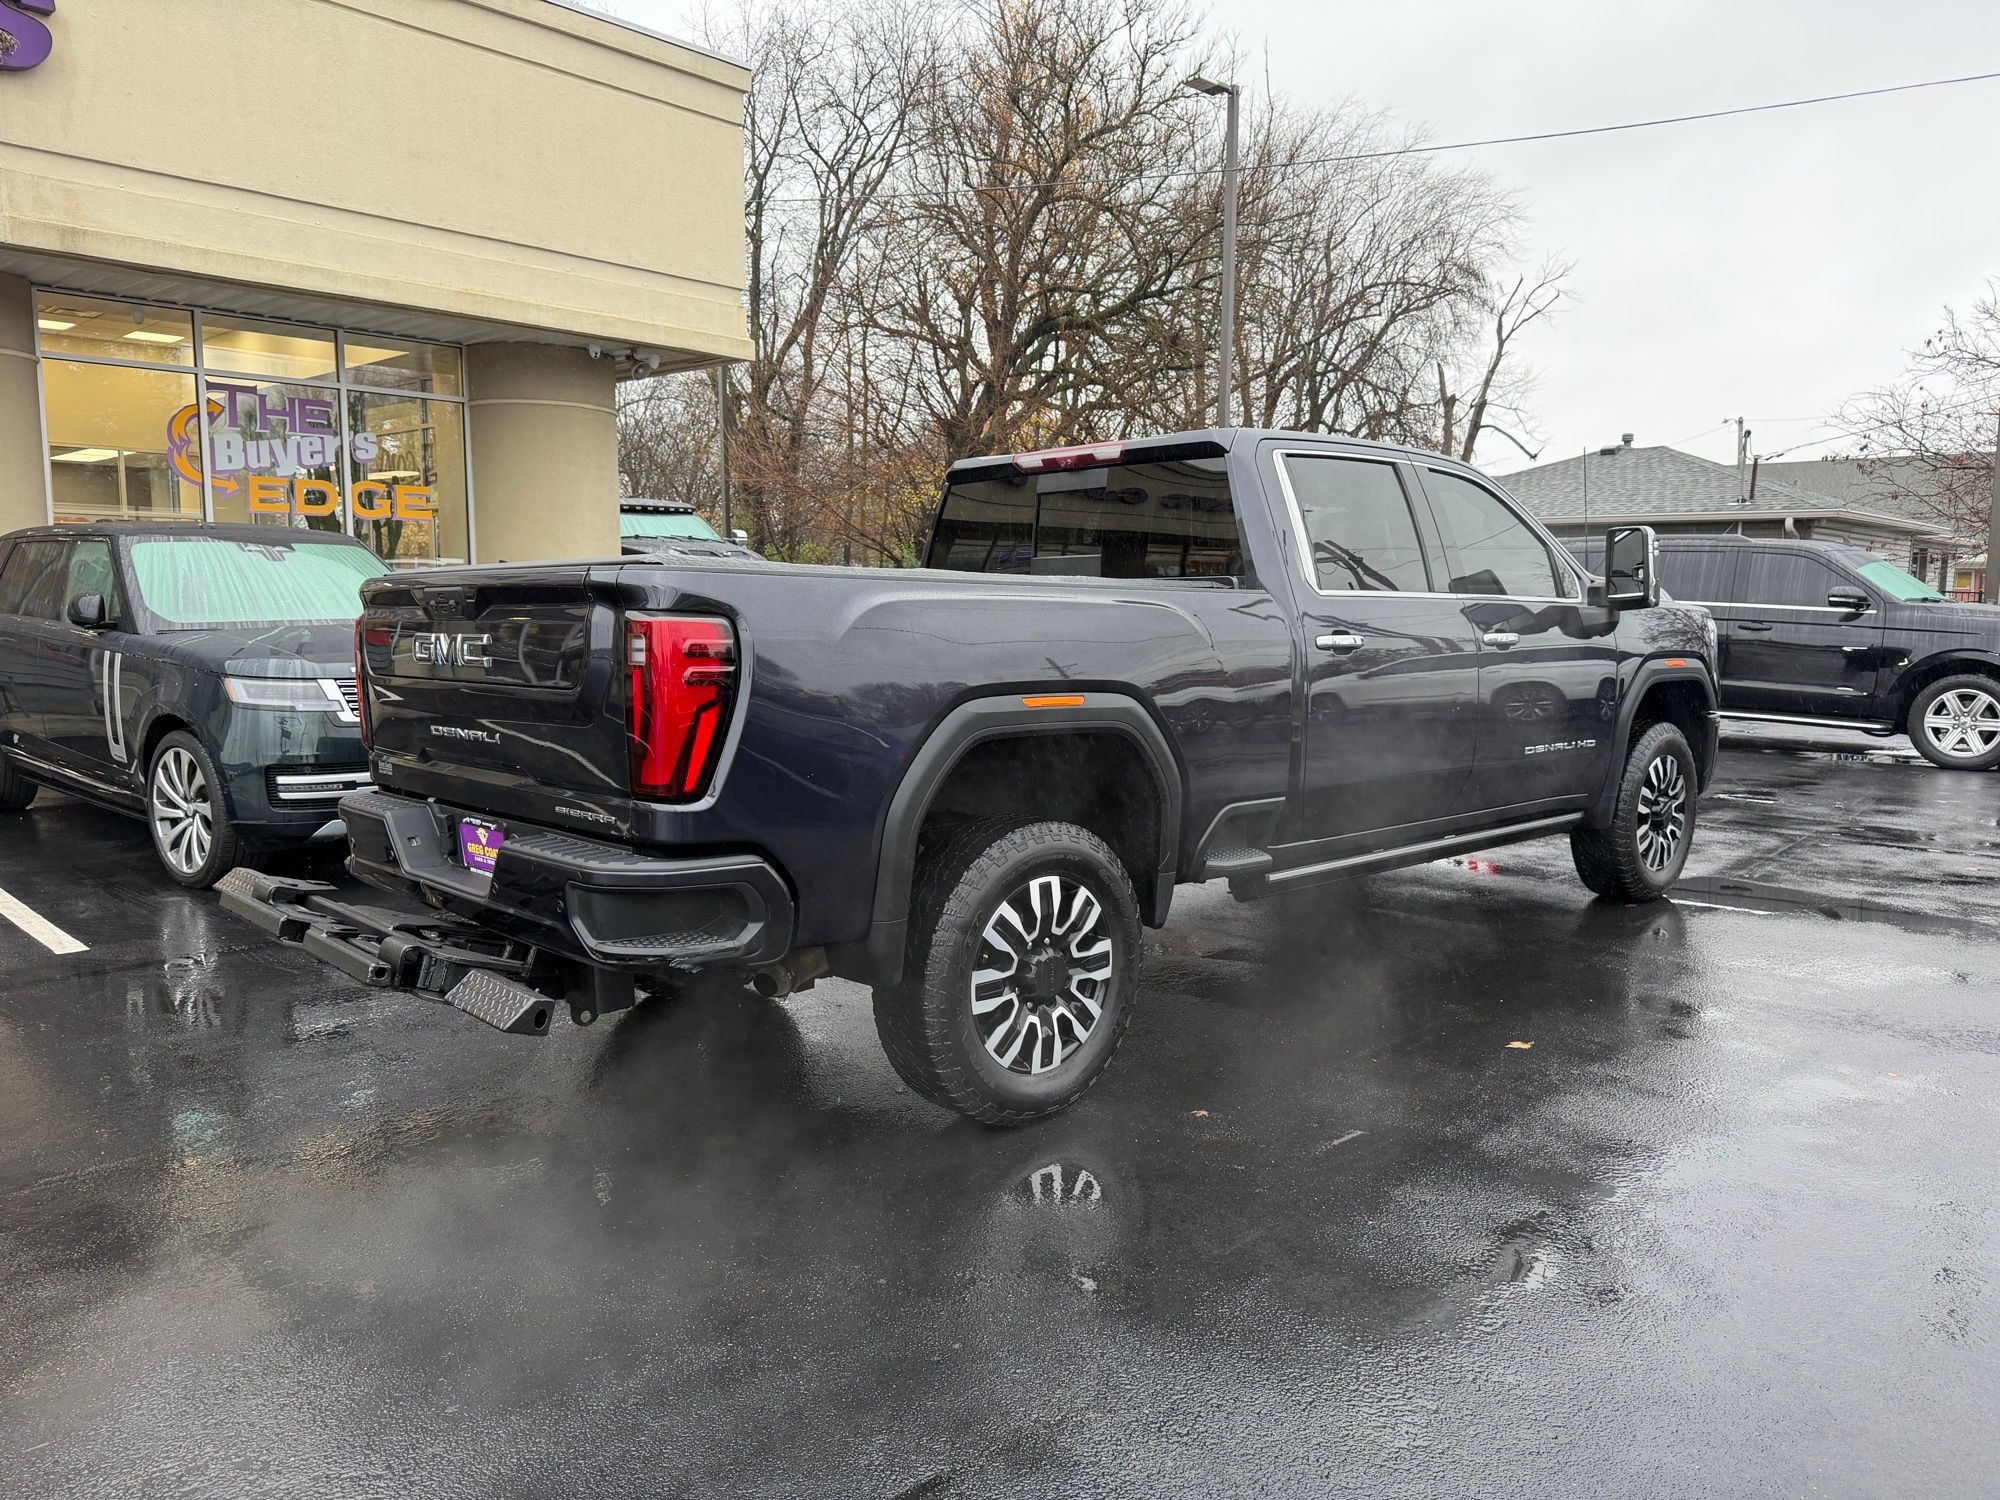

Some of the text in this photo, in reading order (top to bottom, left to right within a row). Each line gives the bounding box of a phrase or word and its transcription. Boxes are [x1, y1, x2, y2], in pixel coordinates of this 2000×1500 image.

[204, 381, 335, 437] THE
[211, 431, 379, 477] Buyer's
[249, 475, 433, 520] EDGE
[412, 632, 493, 668] GMC
[430, 725, 501, 744] DENALI
[1524, 739, 1597, 755] DENALI HD
[554, 805, 617, 825] SIERRA
[467, 842, 484, 856] GREG
